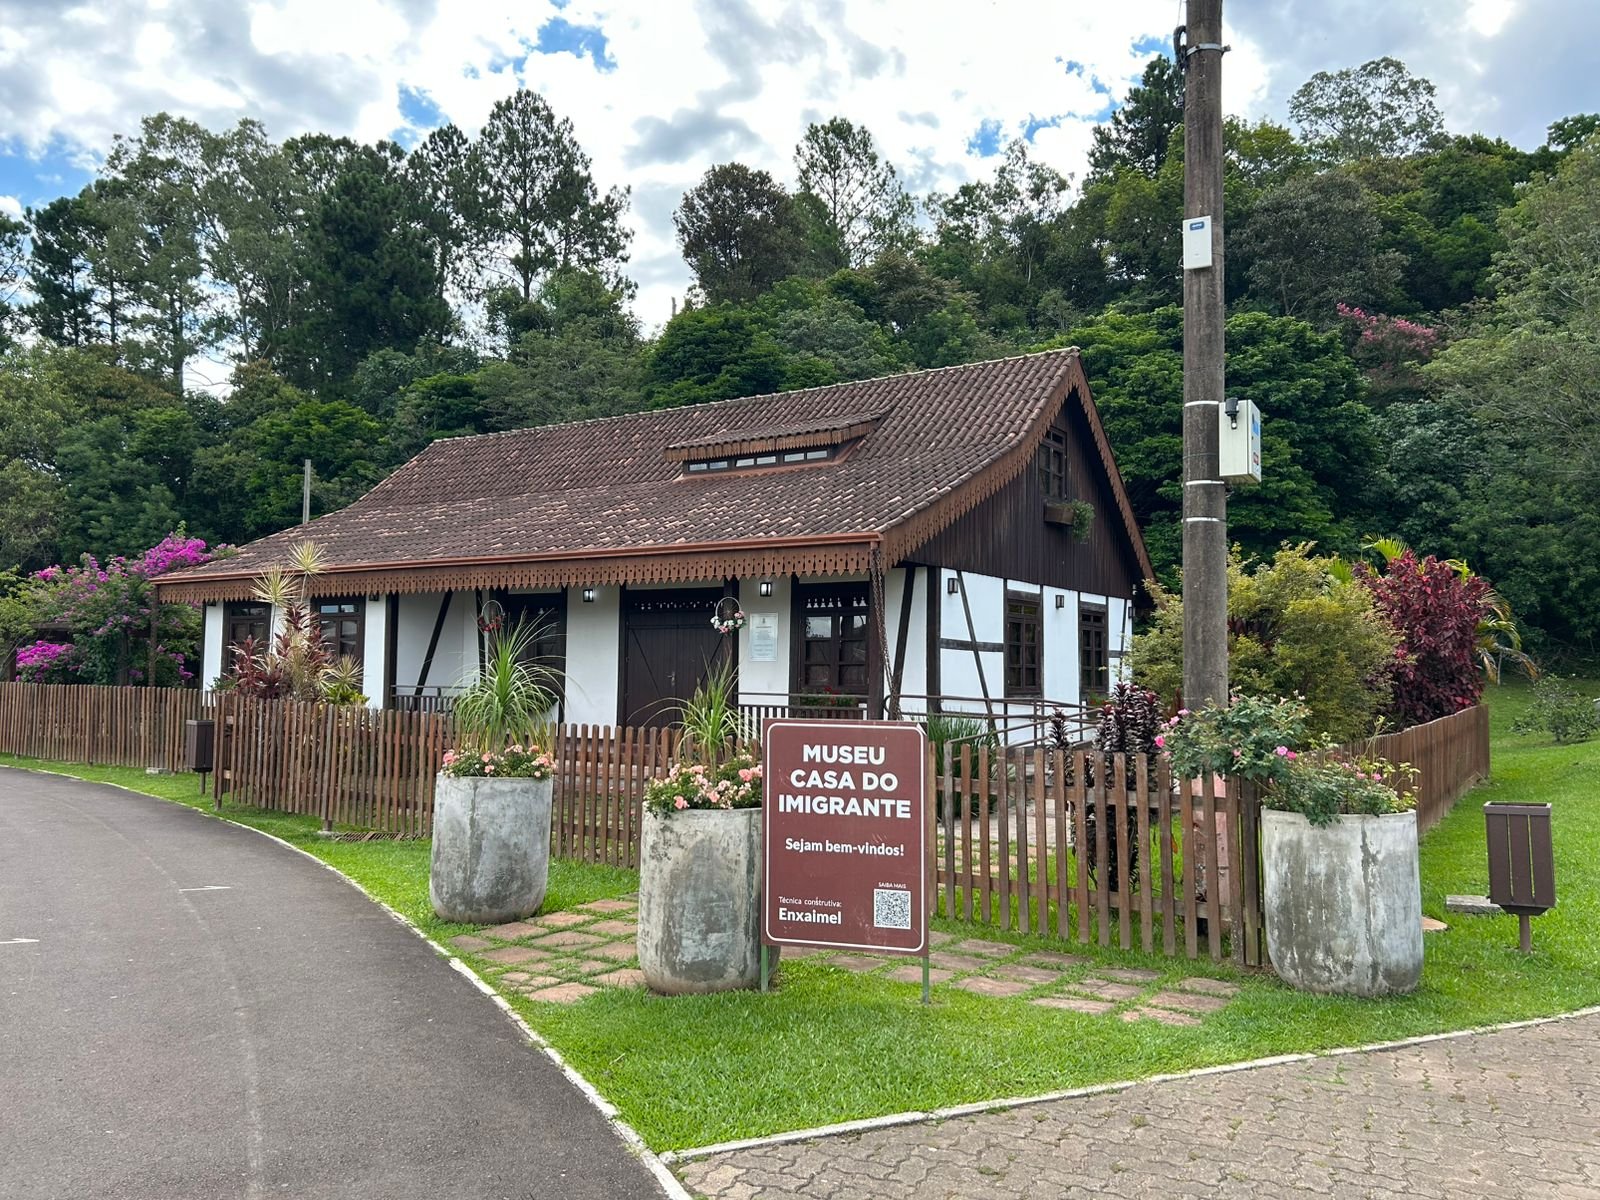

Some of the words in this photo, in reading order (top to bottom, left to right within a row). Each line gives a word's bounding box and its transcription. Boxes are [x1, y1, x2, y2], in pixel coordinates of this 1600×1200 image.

[802, 744, 886, 765] MUSEU
[790, 769, 856, 790] CASA
[862, 772, 899, 792] DO
[778, 794, 912, 819] IMIGRANTE
[785, 838, 823, 853] Sejam
[825, 840, 905, 857] bem-vindos!
[778, 896, 802, 905] Técnica
[804, 897, 842, 908] construtiva:
[778, 907, 842, 925] Enxaimel
